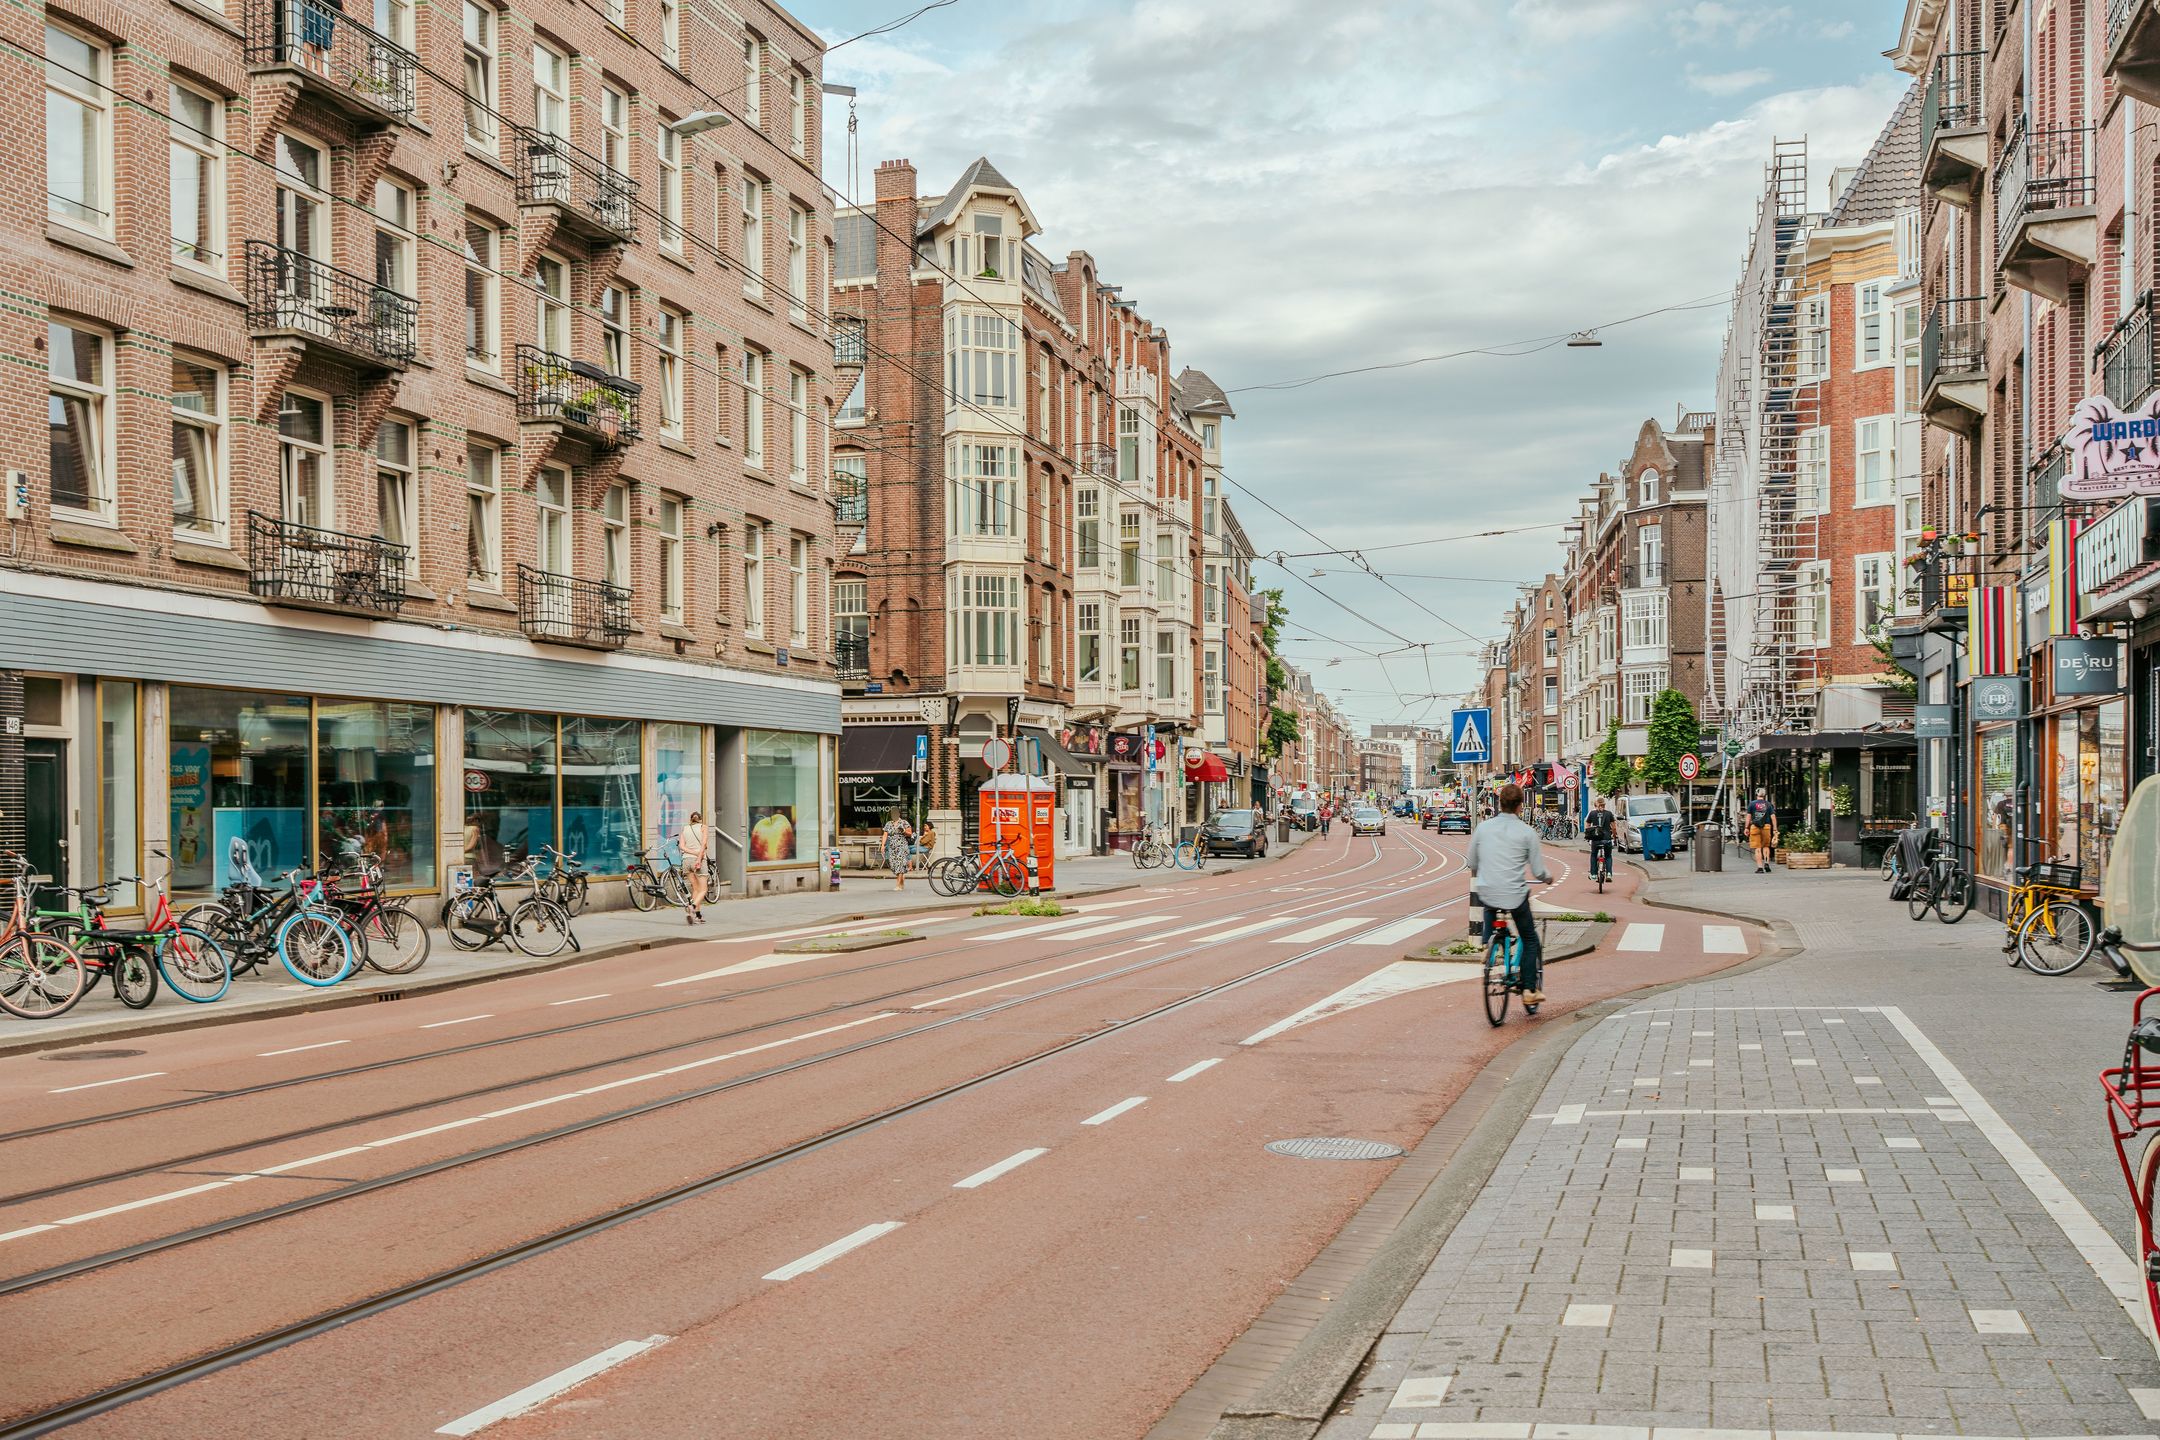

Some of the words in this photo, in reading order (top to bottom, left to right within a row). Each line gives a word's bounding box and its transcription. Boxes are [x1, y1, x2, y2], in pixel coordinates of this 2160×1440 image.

[2093, 419, 2160, 441] WARD
[2129, 447, 2135, 459] 1
[2077, 499, 2145, 596] COFFEESHOP
[1683, 761, 1695, 772] 30
